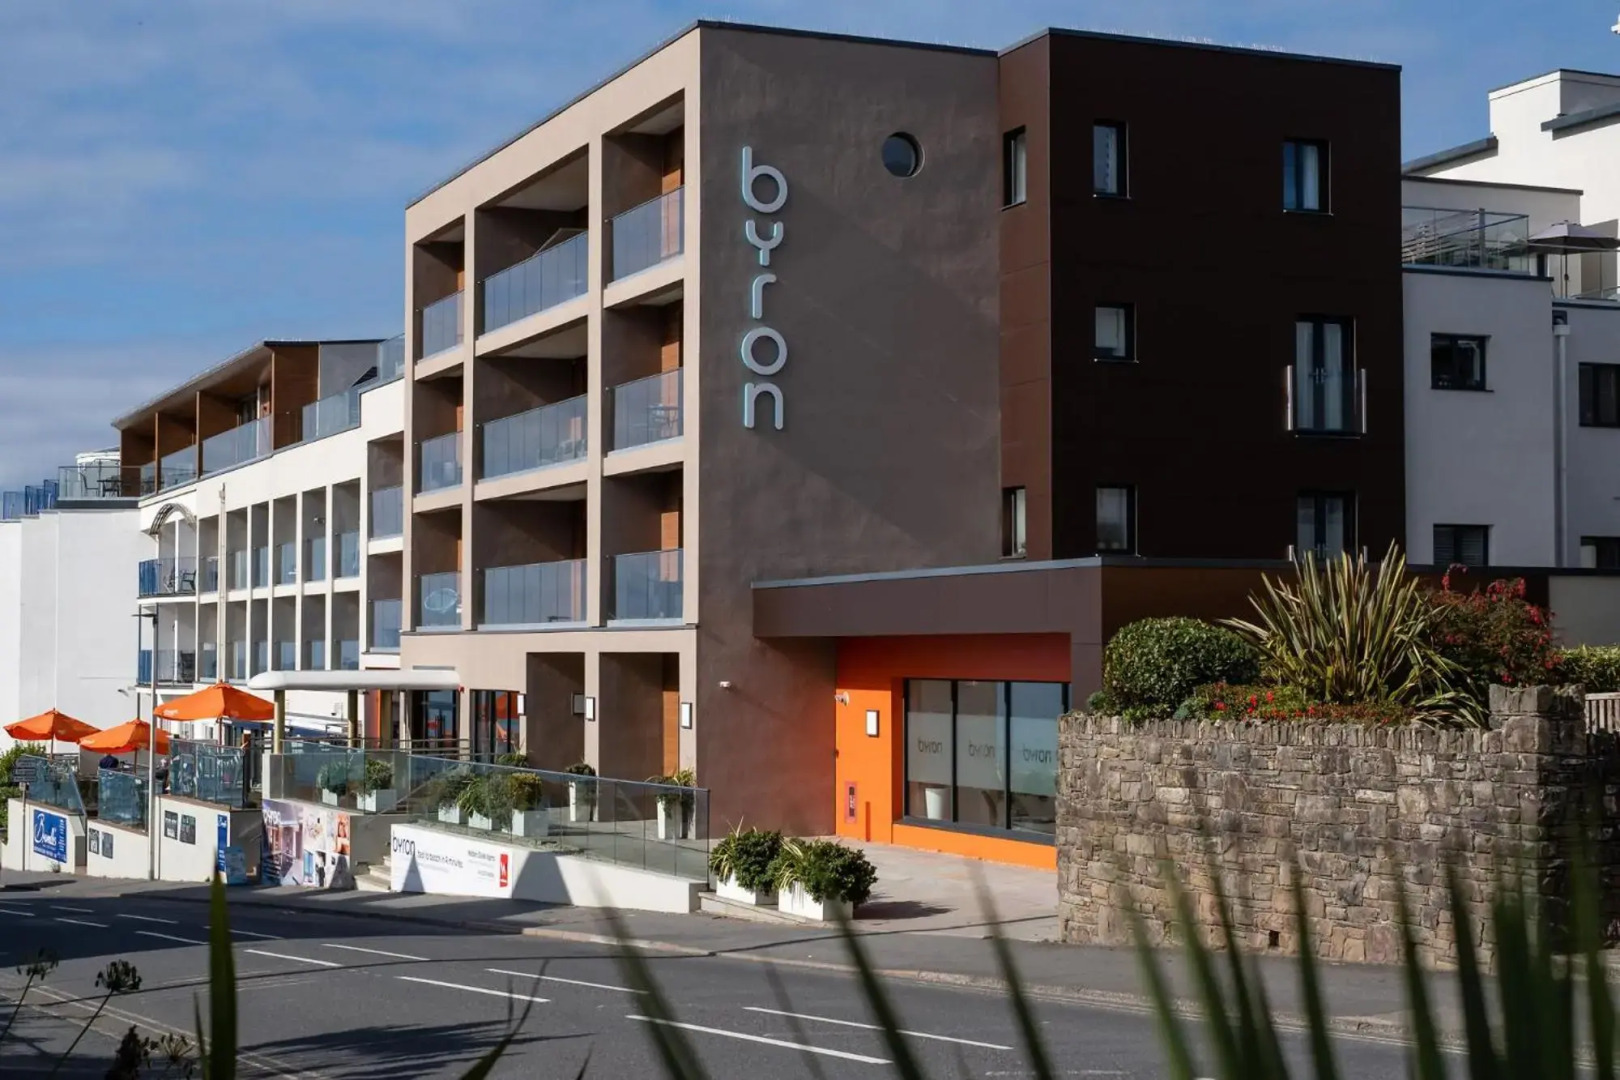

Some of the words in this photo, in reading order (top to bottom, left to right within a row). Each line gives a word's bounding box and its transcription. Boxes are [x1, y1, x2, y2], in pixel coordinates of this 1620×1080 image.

[741, 145, 788, 430] byron
[917, 736, 943, 754] byron
[968, 740, 995, 758] byron
[1023, 744, 1052, 763] byron
[392, 829, 416, 856] byron
